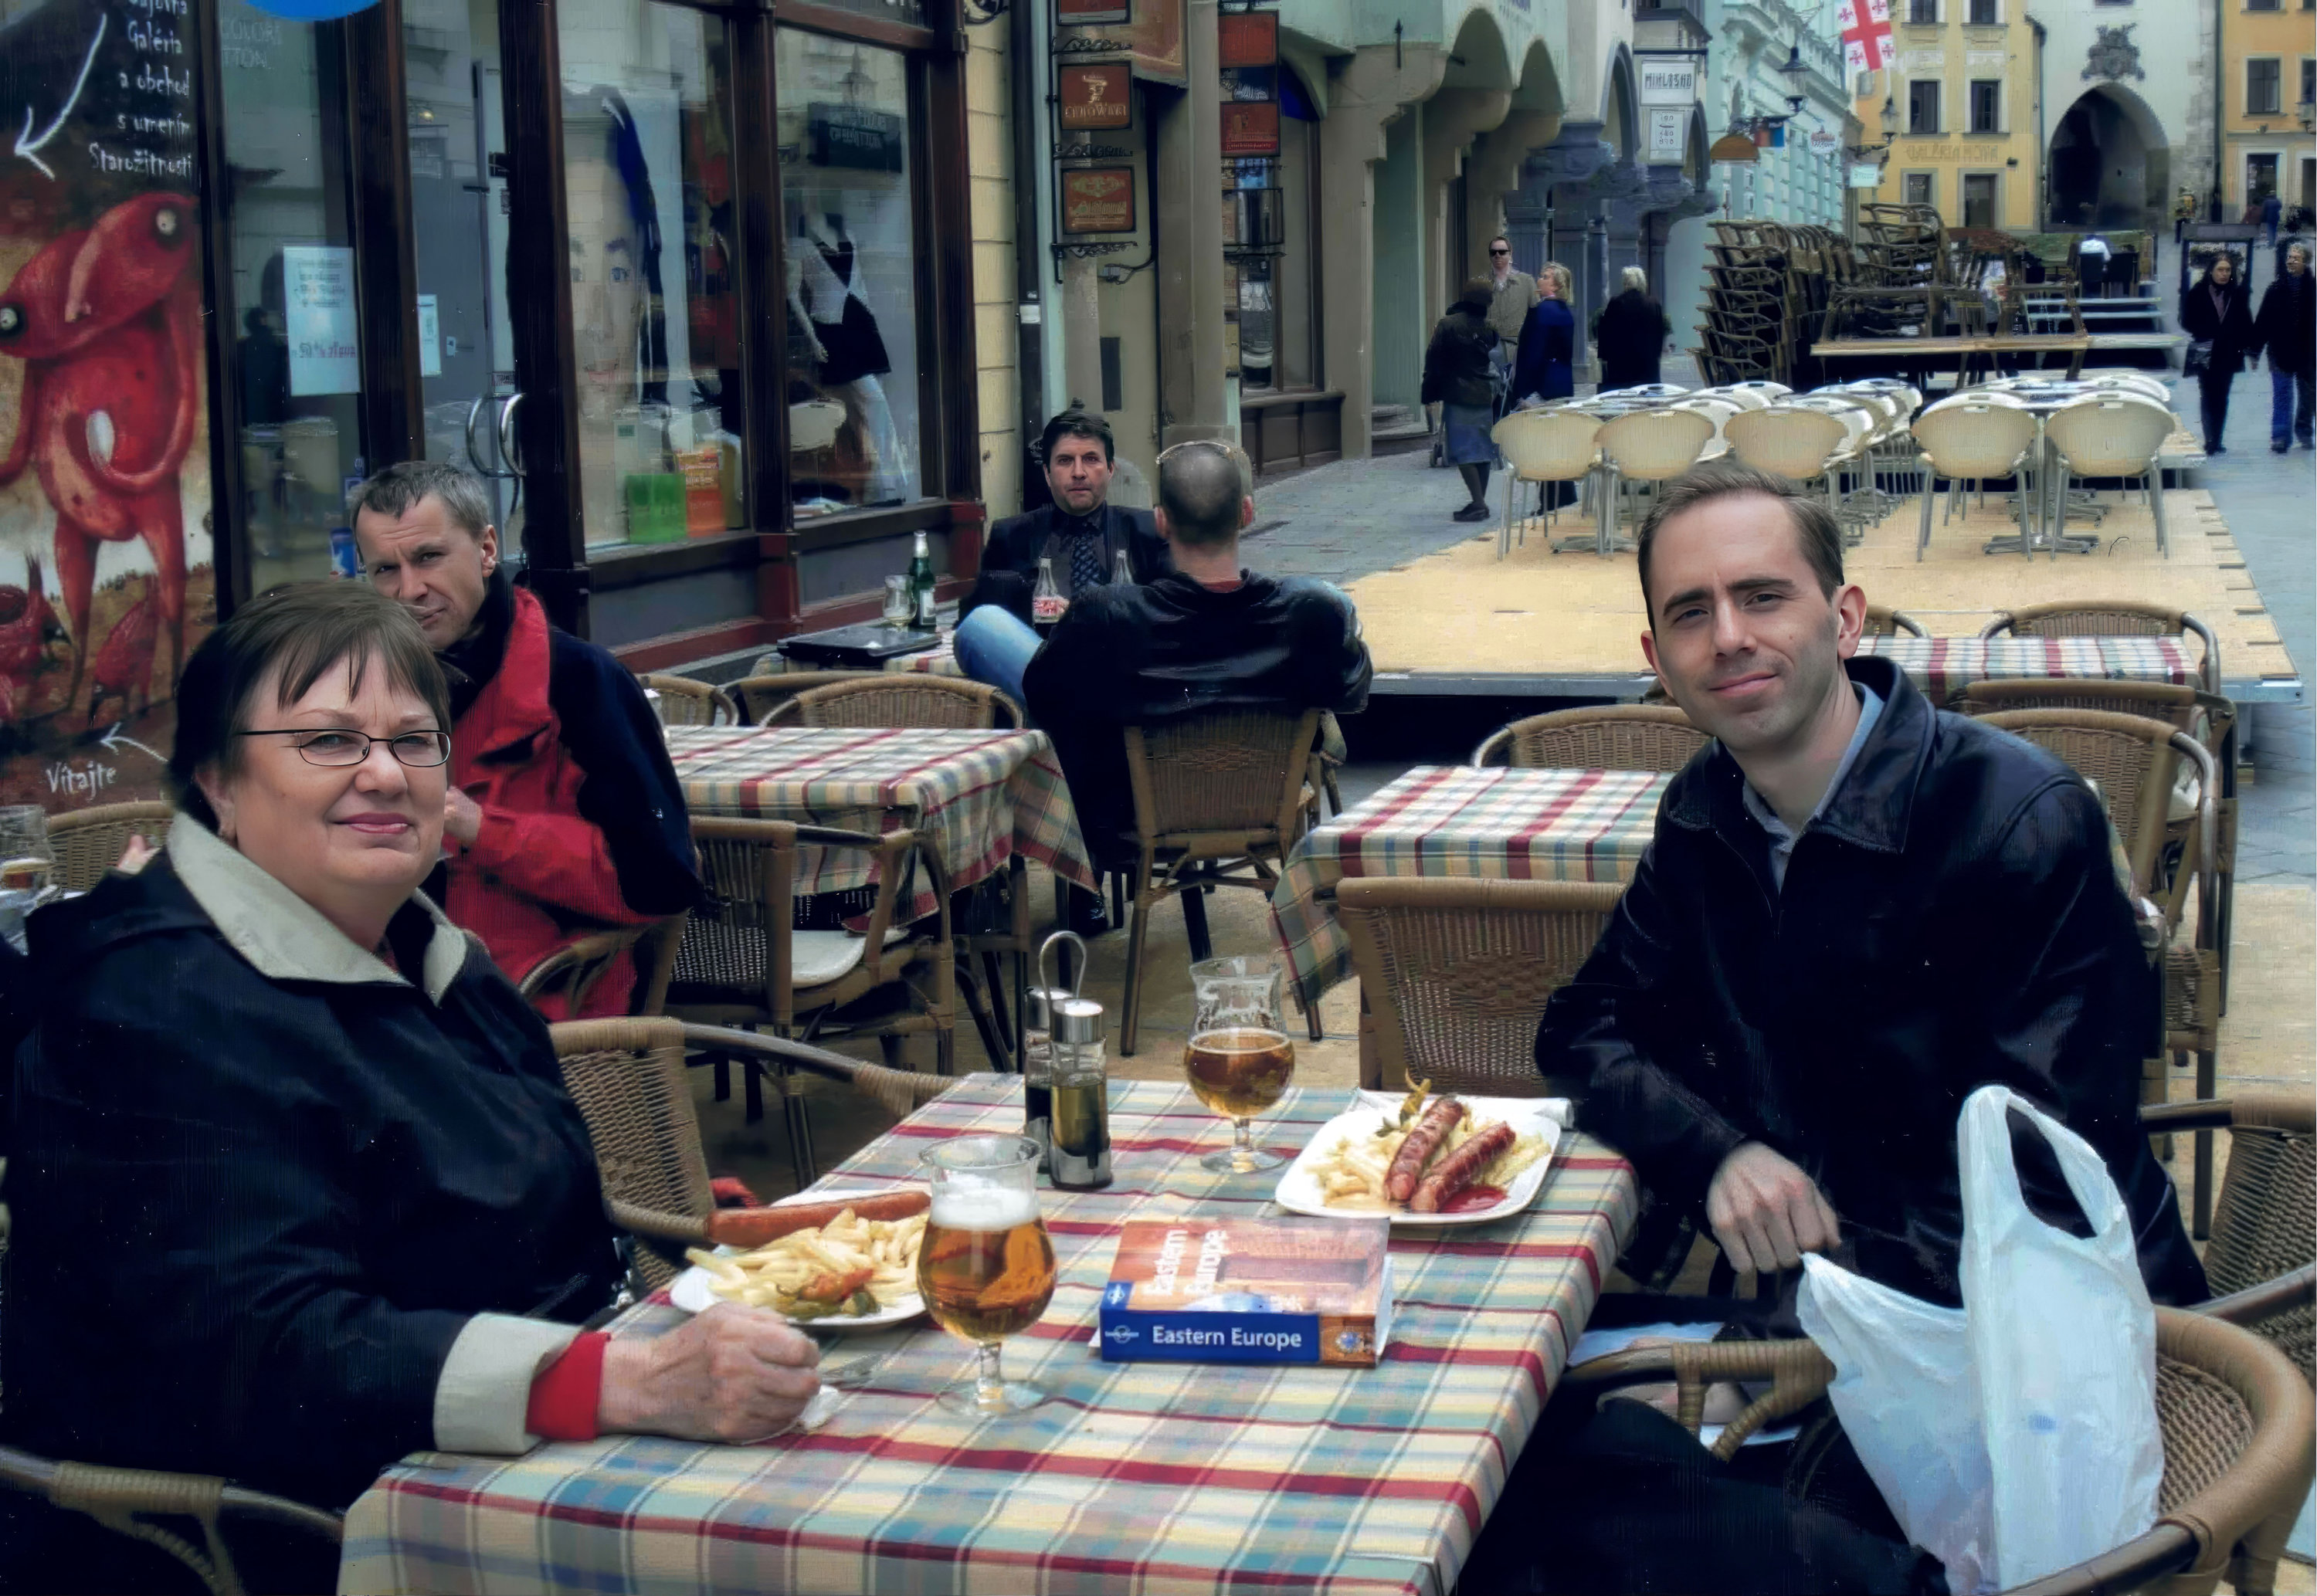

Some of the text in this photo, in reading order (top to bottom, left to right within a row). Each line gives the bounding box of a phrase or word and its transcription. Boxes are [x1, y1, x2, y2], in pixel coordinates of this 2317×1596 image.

[128, 19, 183, 54] Galéria
[119, 71, 129, 90] a
[117, 114, 127, 130] s
[46, 760, 117, 802] Vitajte
[1152, 1325, 1302, 1350] Eastern Europe
